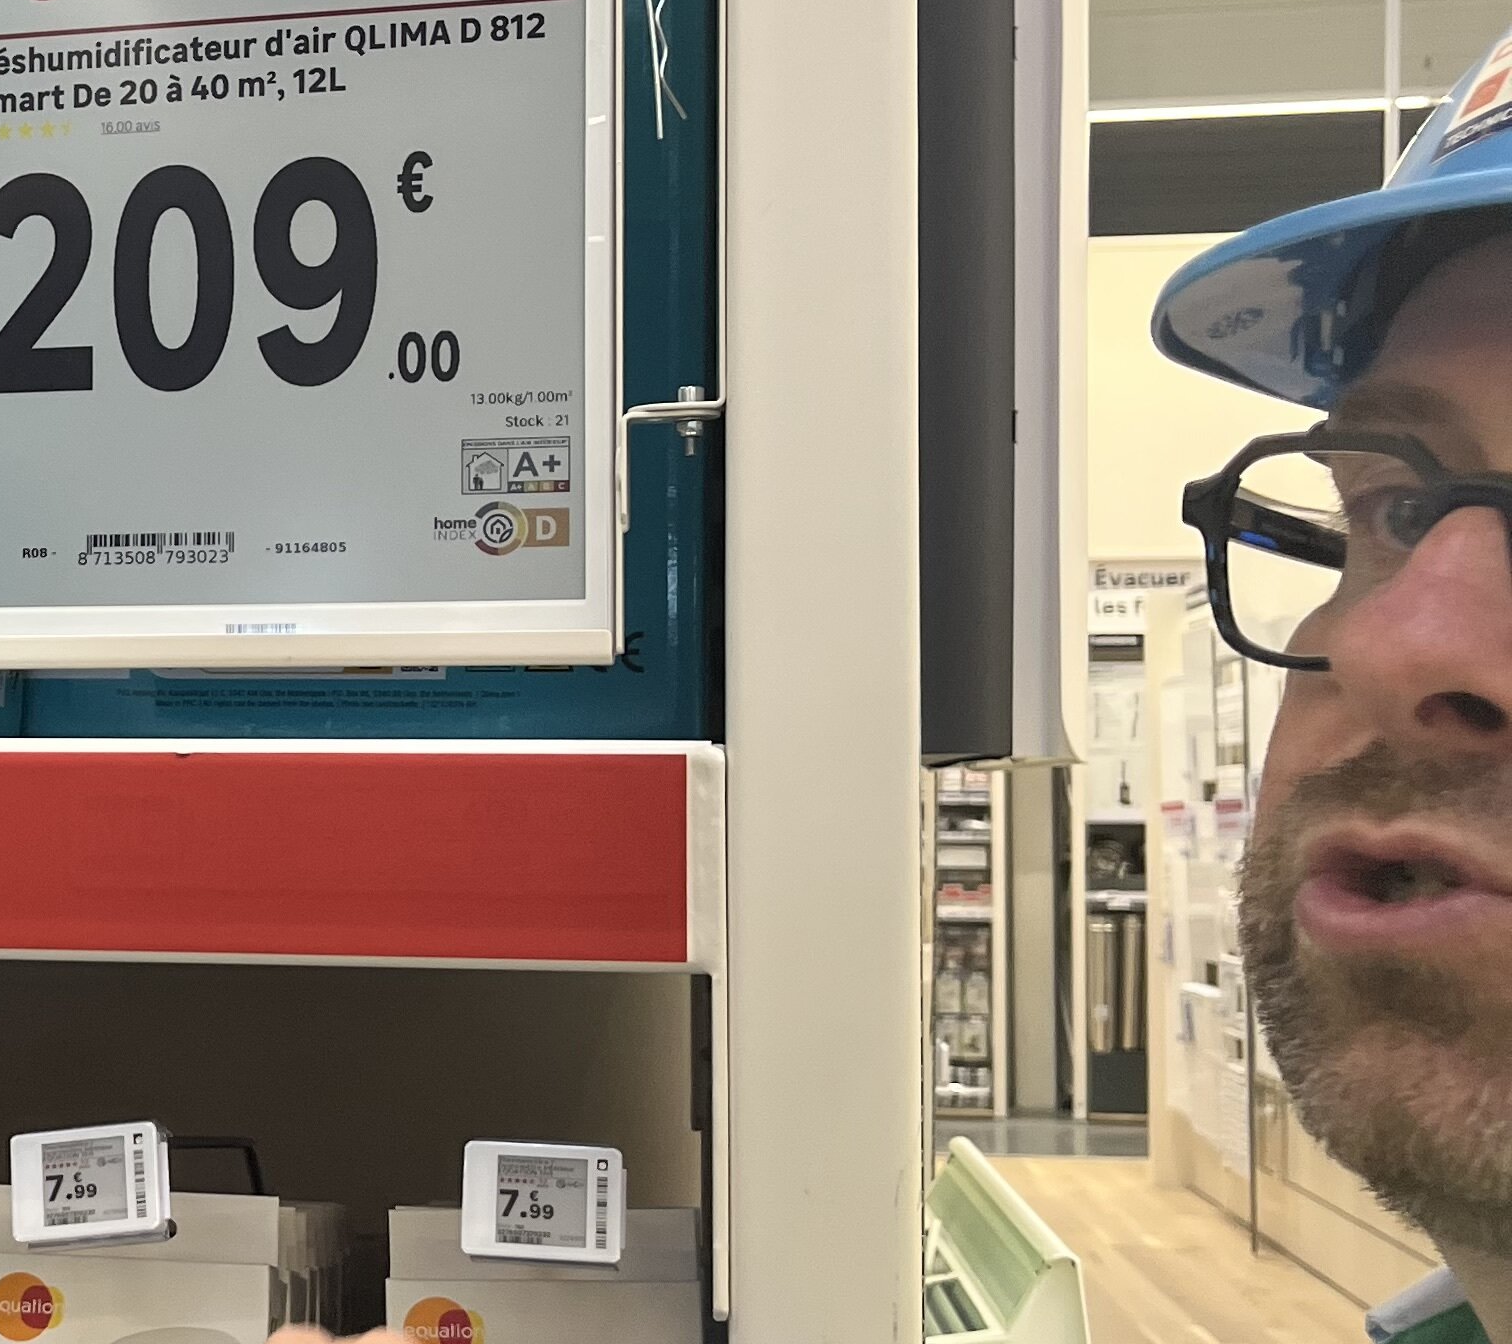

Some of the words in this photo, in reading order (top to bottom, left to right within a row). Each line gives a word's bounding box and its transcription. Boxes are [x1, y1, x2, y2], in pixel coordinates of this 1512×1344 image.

[265, 26, 336, 58] d'air
[344, 18, 451, 56] QLIMA
[460, 17, 482, 44] D
[490, 12, 546, 42] 812
[73, 83, 111, 108] De
[119, 78, 158, 105] 20
[166, 75, 183, 102] à
[191, 74, 229, 100] 40
[292, 66, 346, 94] 12L
[136, 120, 160, 132] avis
[397, 151, 434, 214] €
[506, 415, 544, 427] Stock
[555, 414, 569, 426] 21
[513, 452, 561, 477] A+
[434, 517, 476, 529] home
[434, 530, 476, 540] INDEX
[536, 515, 556, 540] D
[22, 547, 48, 559] R08
[93, 550, 156, 565] 713508
[166, 549, 229, 565] 793023
[274, 542, 347, 554] 91164805
[1095, 563, 1190, 587] Évacuer
[1094, 595, 1127, 614] les
[45, 1174, 98, 1202] 7.99
[499, 1188, 554, 1220] 7.99
